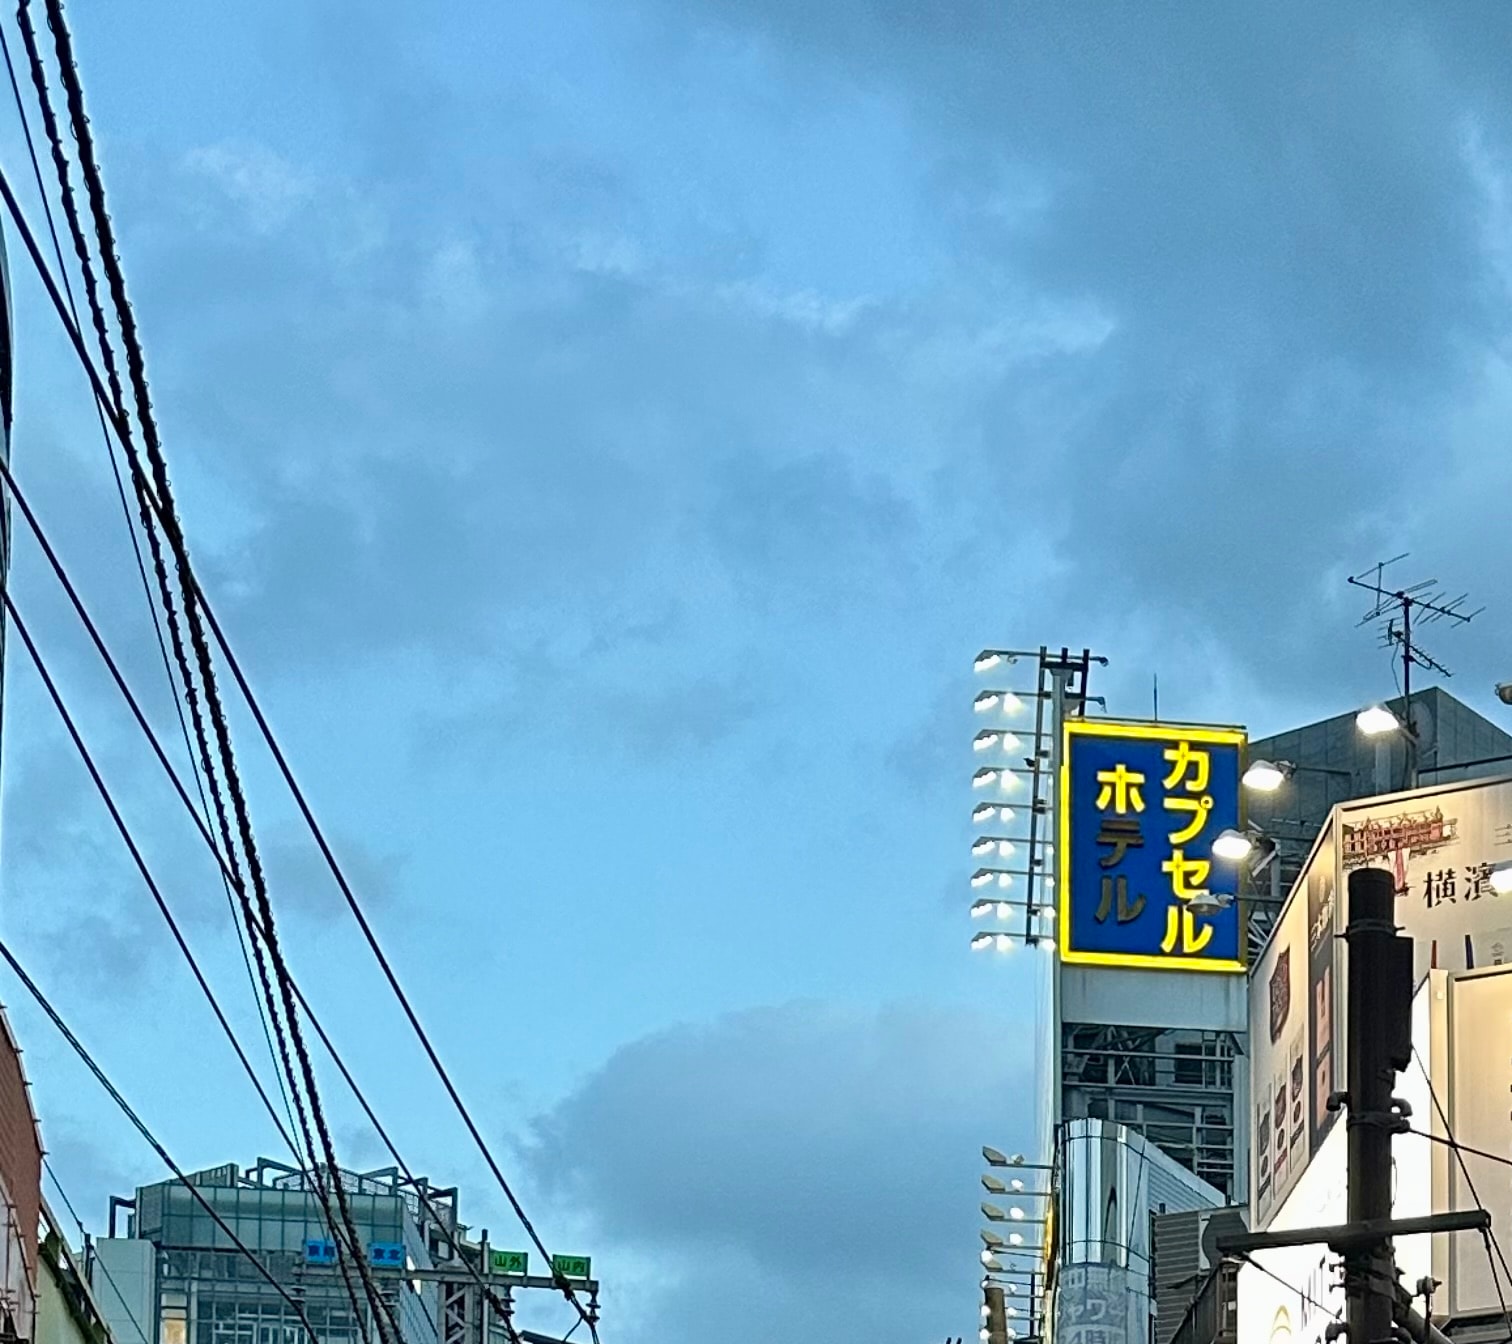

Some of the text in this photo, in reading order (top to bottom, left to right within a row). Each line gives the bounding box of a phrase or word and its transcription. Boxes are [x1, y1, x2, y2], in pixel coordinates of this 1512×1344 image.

[1094, 762, 1147, 925] ホテル
[1161, 740, 1214, 956] カプセル
